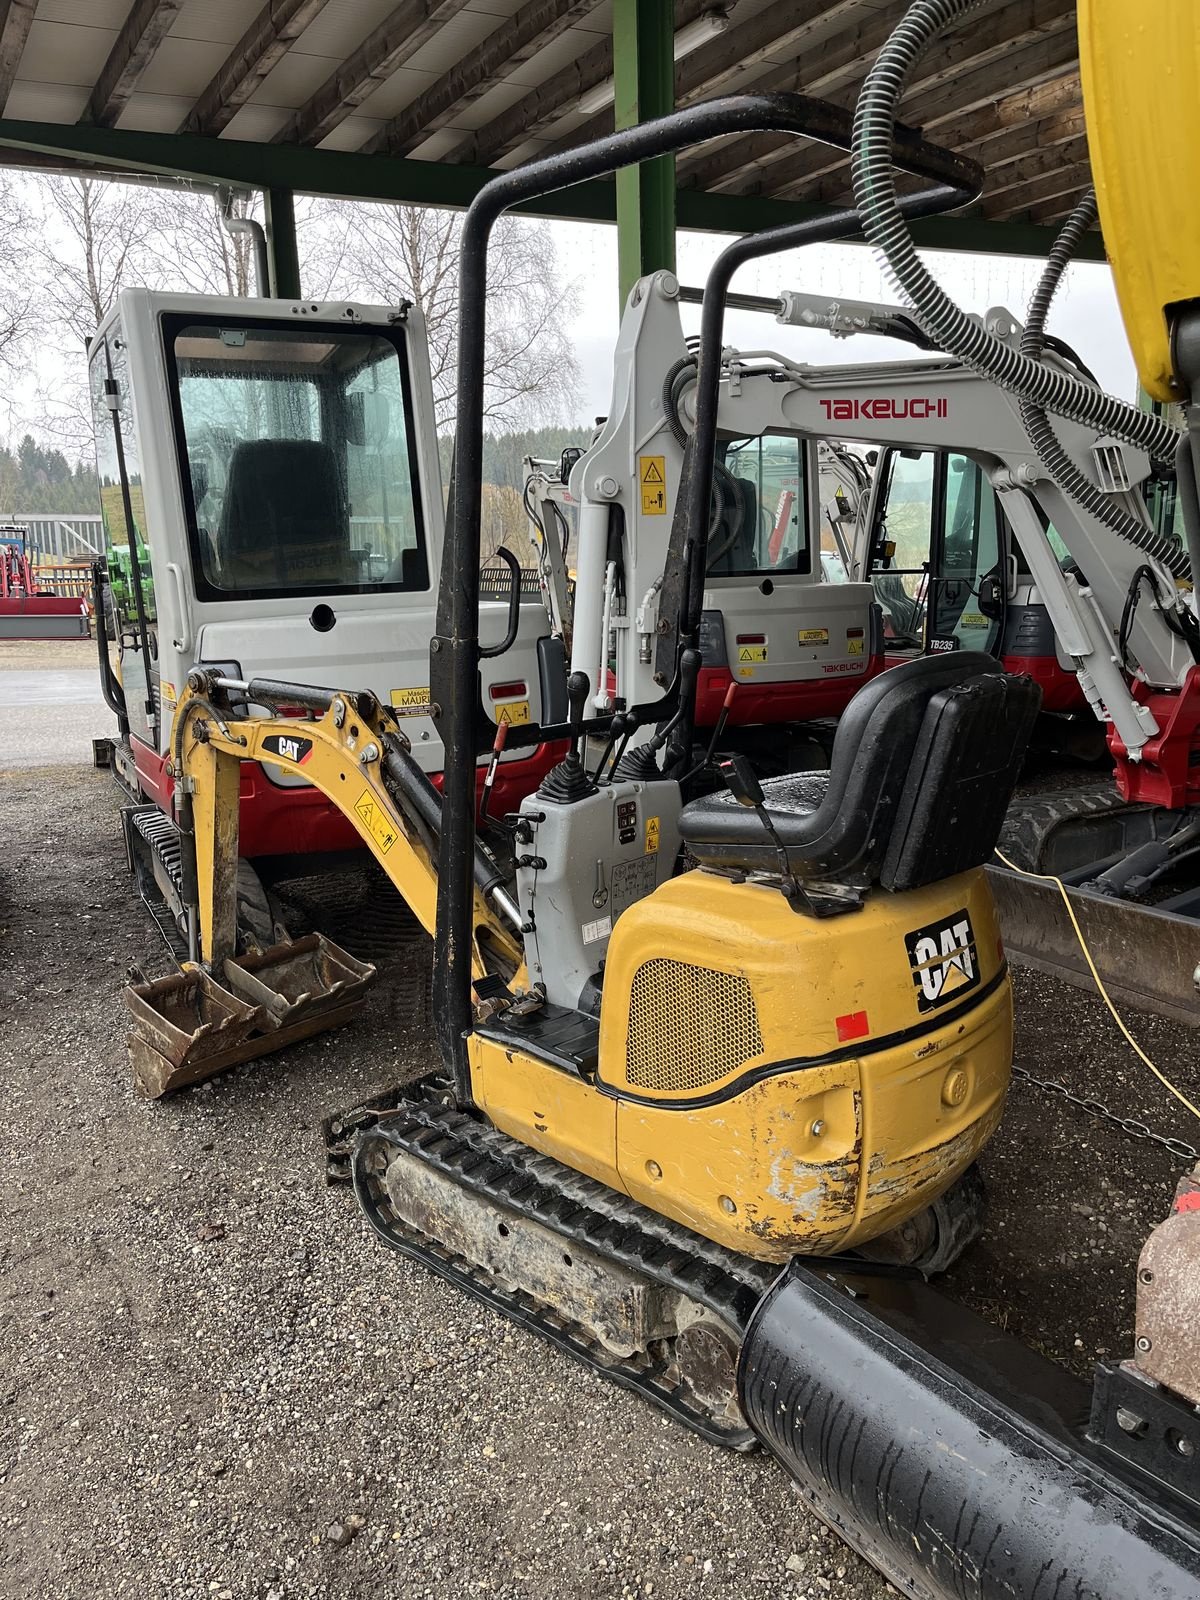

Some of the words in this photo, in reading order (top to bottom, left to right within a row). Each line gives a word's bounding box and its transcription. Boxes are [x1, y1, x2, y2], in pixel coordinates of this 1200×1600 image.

[819, 398, 948, 420] TAKEUCHI
[930, 640, 955, 651] TB235
[821, 662, 864, 673] TAKEUCHI
[278, 736, 300, 762] CAT
[914, 919, 974, 1000] CAT
